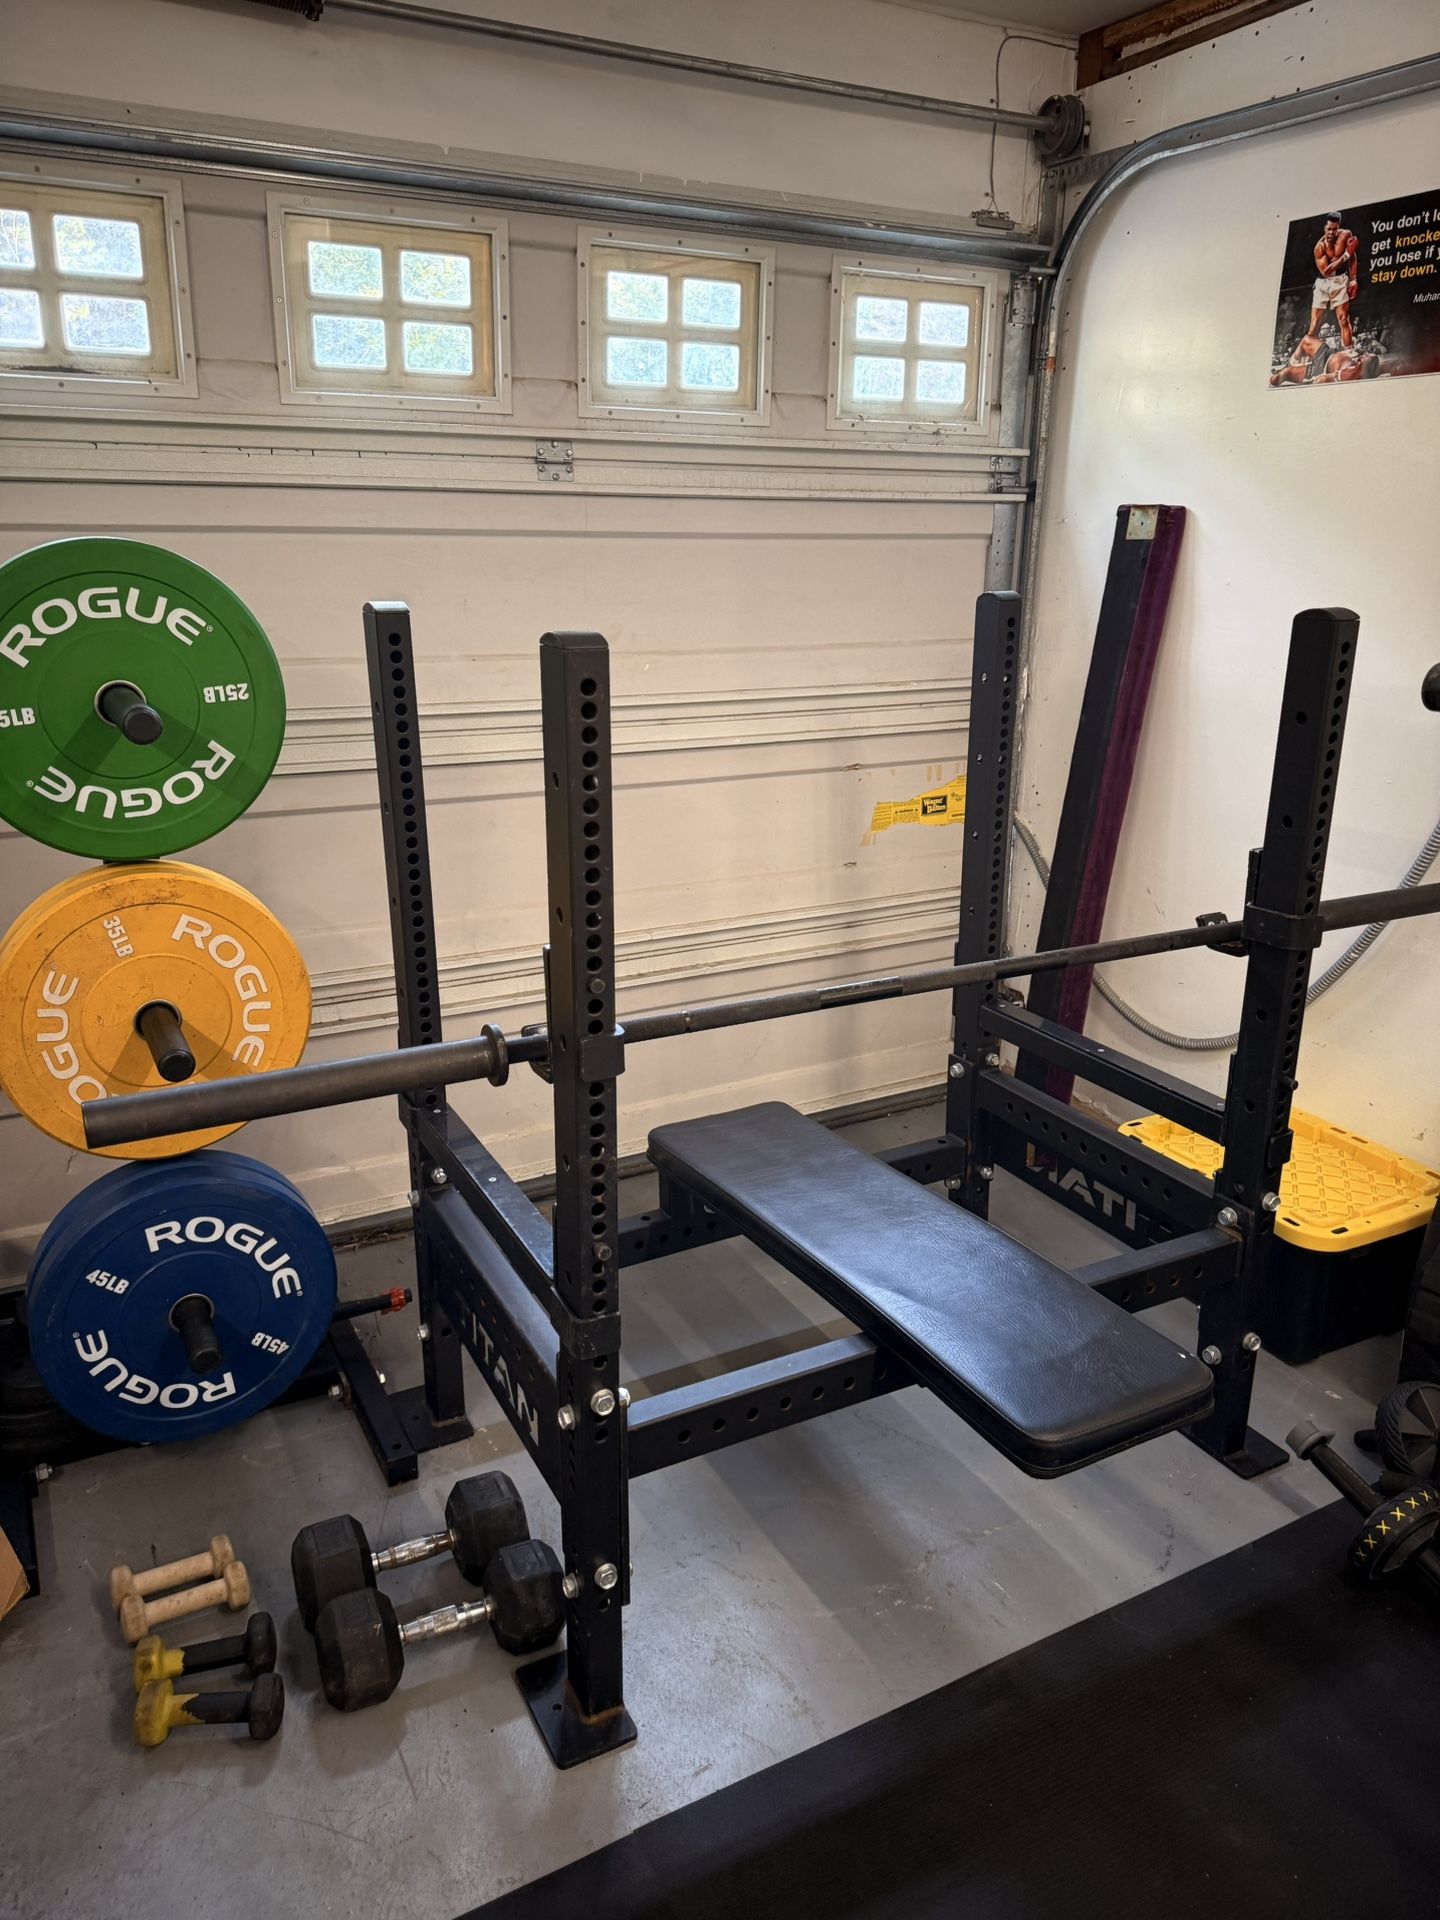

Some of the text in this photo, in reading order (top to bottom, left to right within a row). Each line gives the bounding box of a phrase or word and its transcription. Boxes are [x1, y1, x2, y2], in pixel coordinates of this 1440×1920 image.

[1371, 219, 1394, 234] You
[1397, 211, 1430, 229] don't
[1369, 255, 1393, 272] you
[1396, 251, 1421, 264] lose
[1425, 245, 1436, 258] if
[1371, 229, 1440, 255] get knocke
[1371, 264, 1438, 284] stay down.
[0, 586, 207, 668] ROGUE
[203, 683, 249, 703] 25LB
[33, 740, 236, 819] ROGUE
[102, 915, 134, 958] 35LB
[171, 913, 272, 1067] ROGUE
[36, 969, 116, 1106] OGUE
[144, 1216, 302, 1299] ROGUE
[85, 1269, 130, 1295] 45LB
[250, 1331, 290, 1355] 45LB
[74, 1329, 237, 1409] ROGUE
